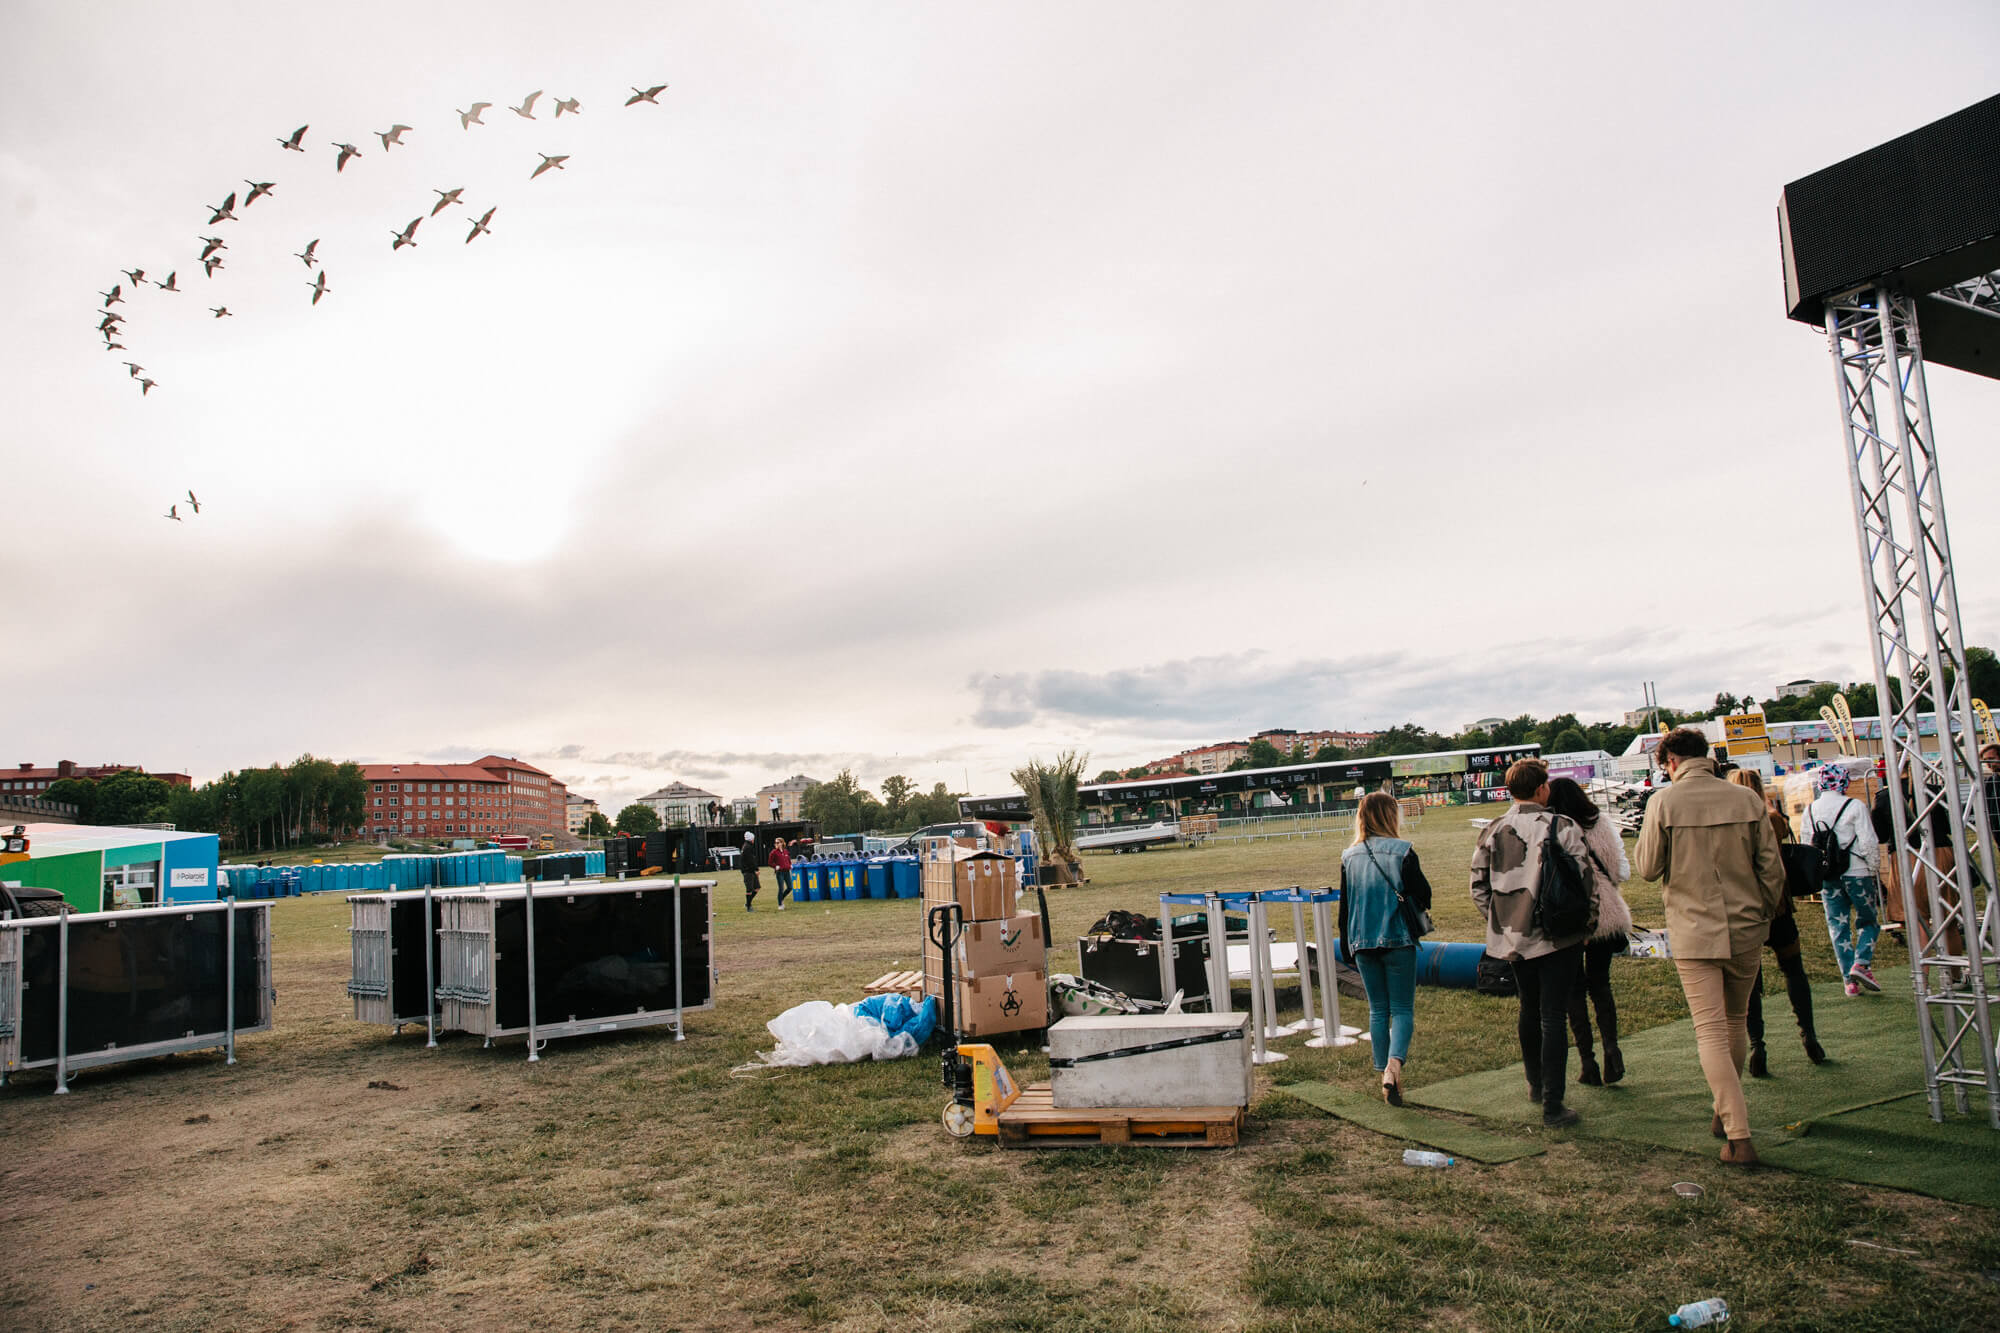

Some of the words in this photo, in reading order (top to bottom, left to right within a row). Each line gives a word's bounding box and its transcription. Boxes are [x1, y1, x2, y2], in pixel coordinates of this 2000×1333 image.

[1471, 755, 1490, 764] NICE
[1487, 790, 1506, 800] NICE
[181, 872, 205, 880] Polaroid
